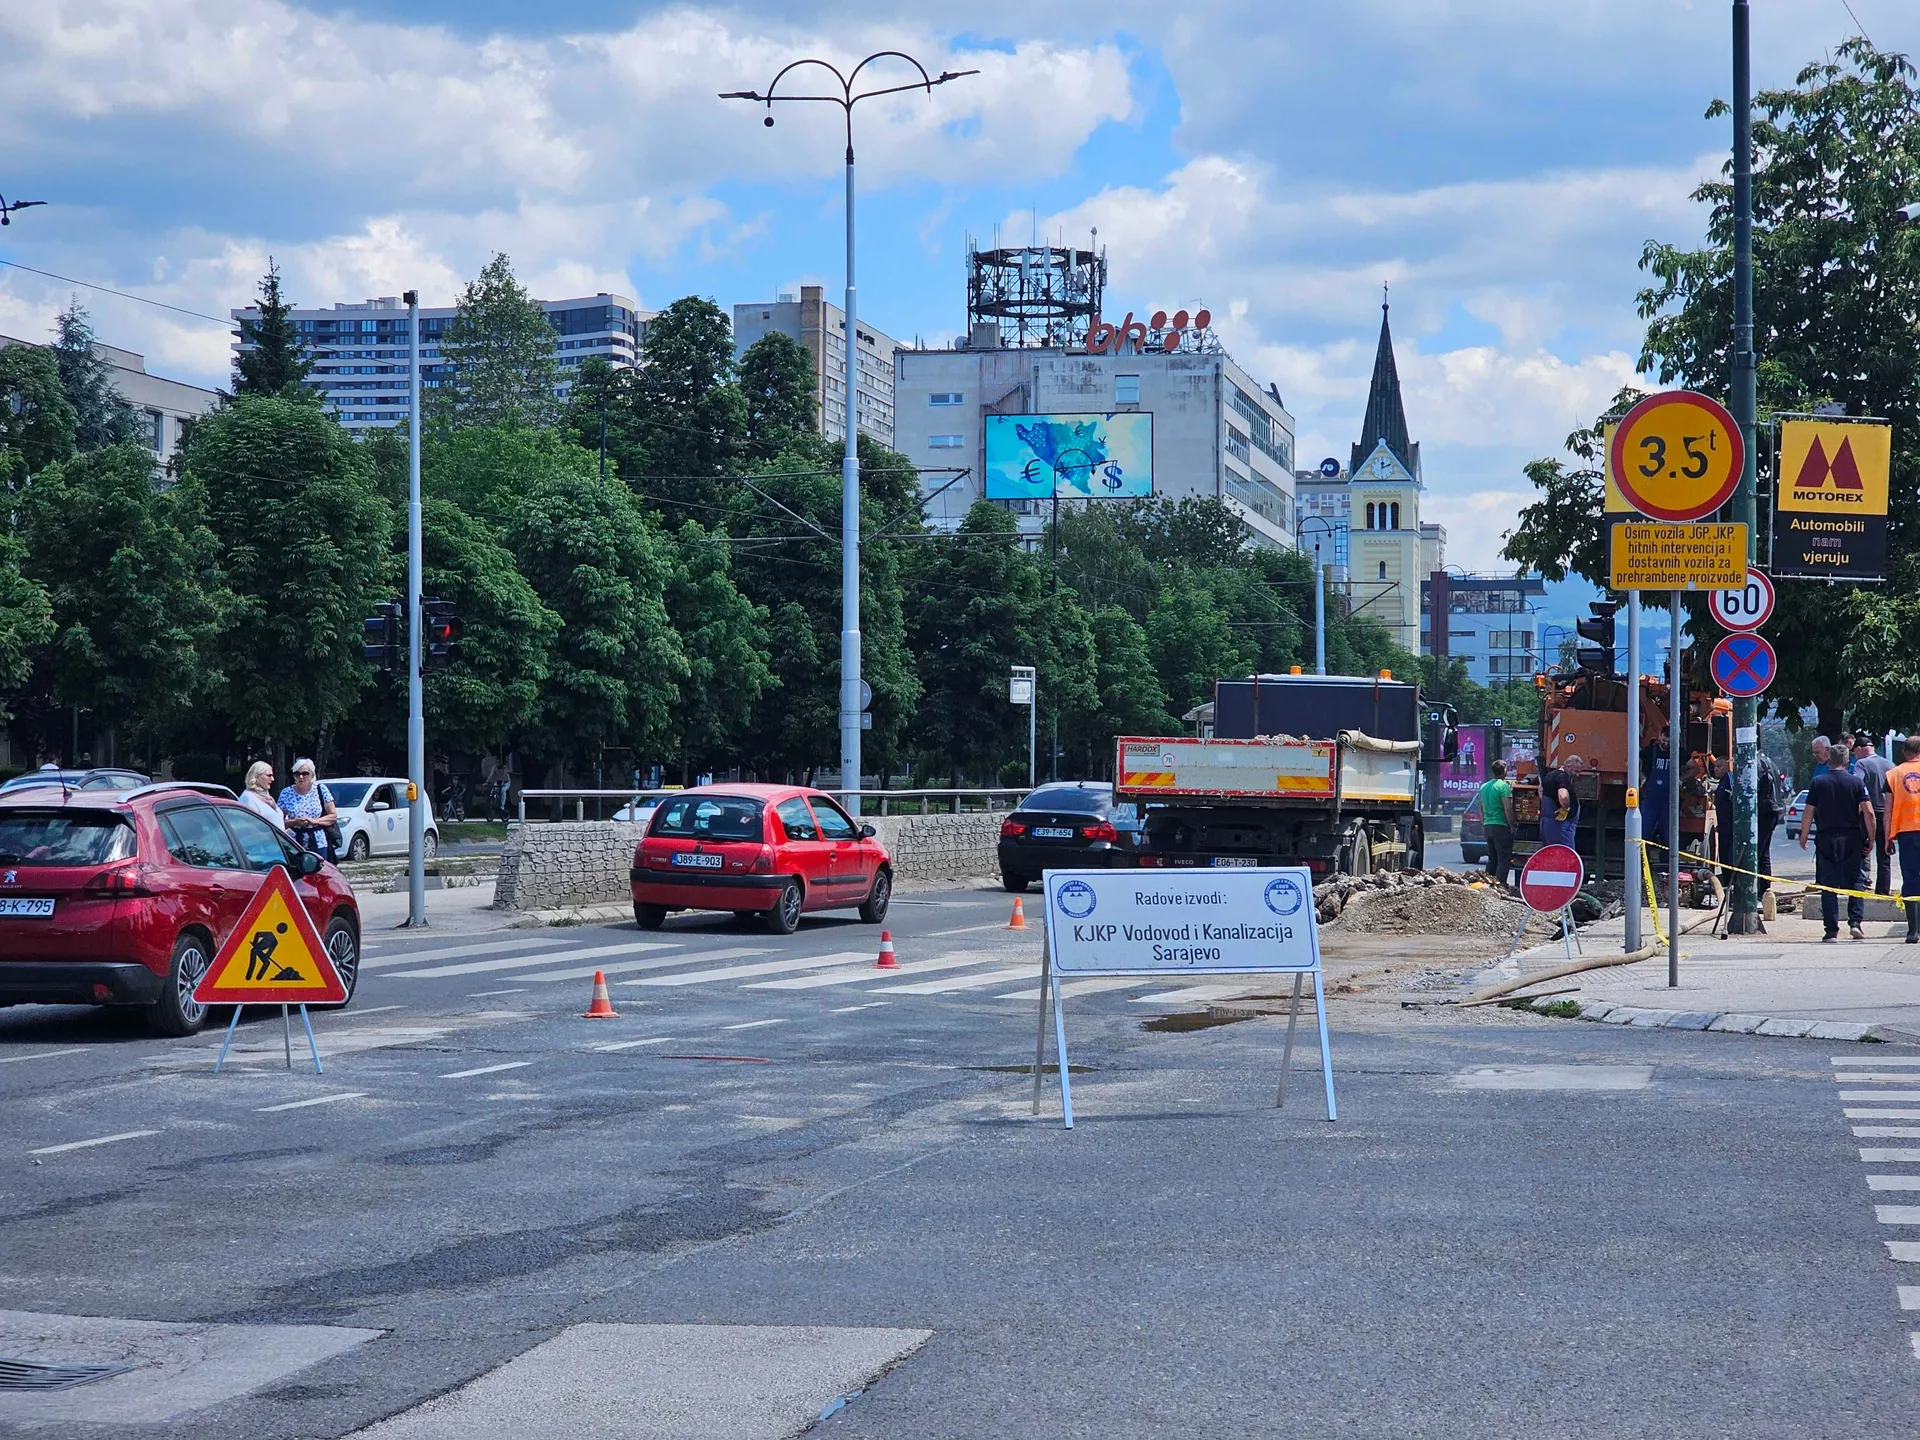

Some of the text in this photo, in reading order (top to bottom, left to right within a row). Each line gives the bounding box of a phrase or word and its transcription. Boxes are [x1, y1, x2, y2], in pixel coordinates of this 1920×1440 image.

[1793, 491, 1863, 502] MOTOREX
[1790, 518, 1865, 532] Automobili
[1625, 526, 1650, 539] Osim
[1654, 527, 1685, 539] vozila
[1628, 541, 1731, 557] hitnih intervencija i
[1812, 537, 1842, 547] nam
[1628, 555, 1731, 568] dostavnih vozila za
[1803, 551, 1849, 566] vjeruju
[1616, 570, 1742, 586] prehrambene proizvode
[1724, 584, 1759, 615] 60
[677, 855, 721, 866] J89-E-903
[1135, 892, 1183, 905] Radove
[1074, 923, 1293, 943] KJKP Vodovod i Kanalizacija
[1153, 944, 1221, 965] Sarajevo
